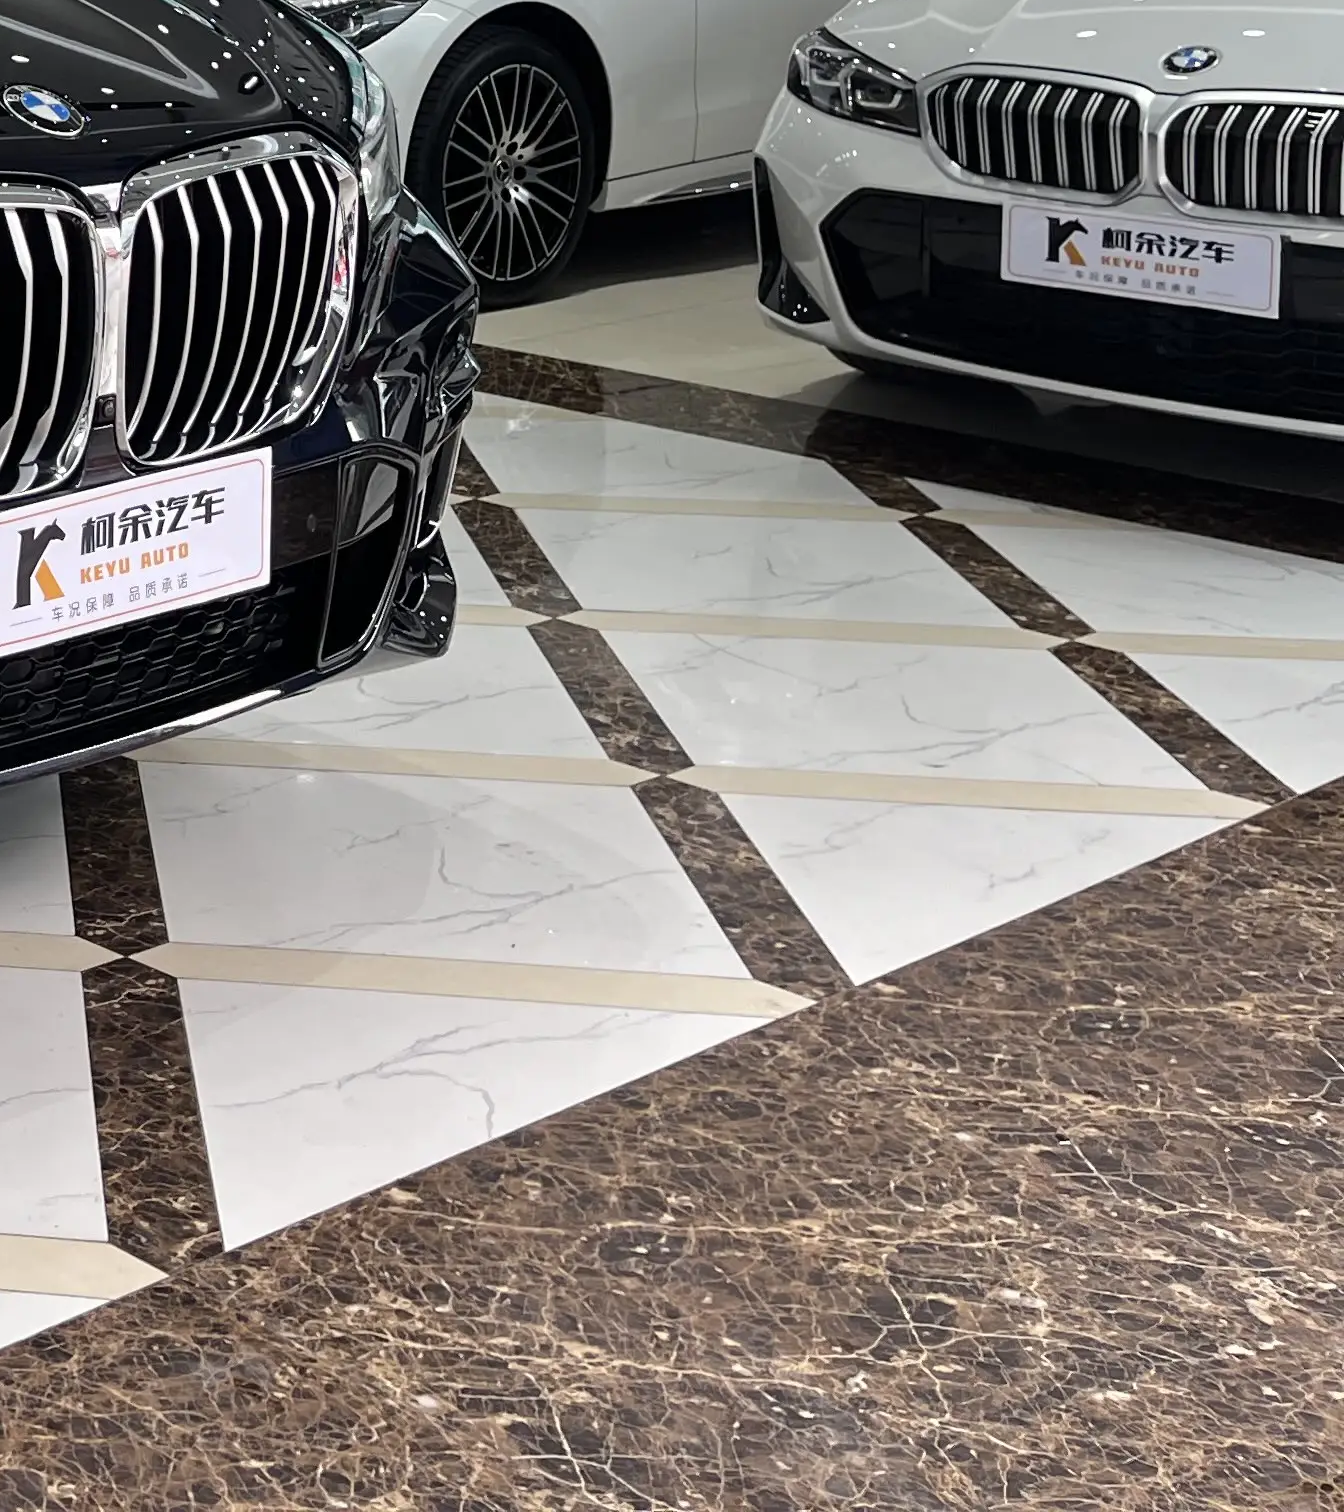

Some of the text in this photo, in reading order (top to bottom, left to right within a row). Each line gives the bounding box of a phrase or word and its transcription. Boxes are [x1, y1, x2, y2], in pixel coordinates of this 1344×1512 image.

[1100, 255, 1201, 278] KEYU AUTO
[1101, 226, 1235, 265] 柯余汽车
[80, 486, 226, 556] 柯余汽车
[79, 542, 190, 585] KEYU AUTO
[50, 572, 190, 623] 车况保障 品质承诺
